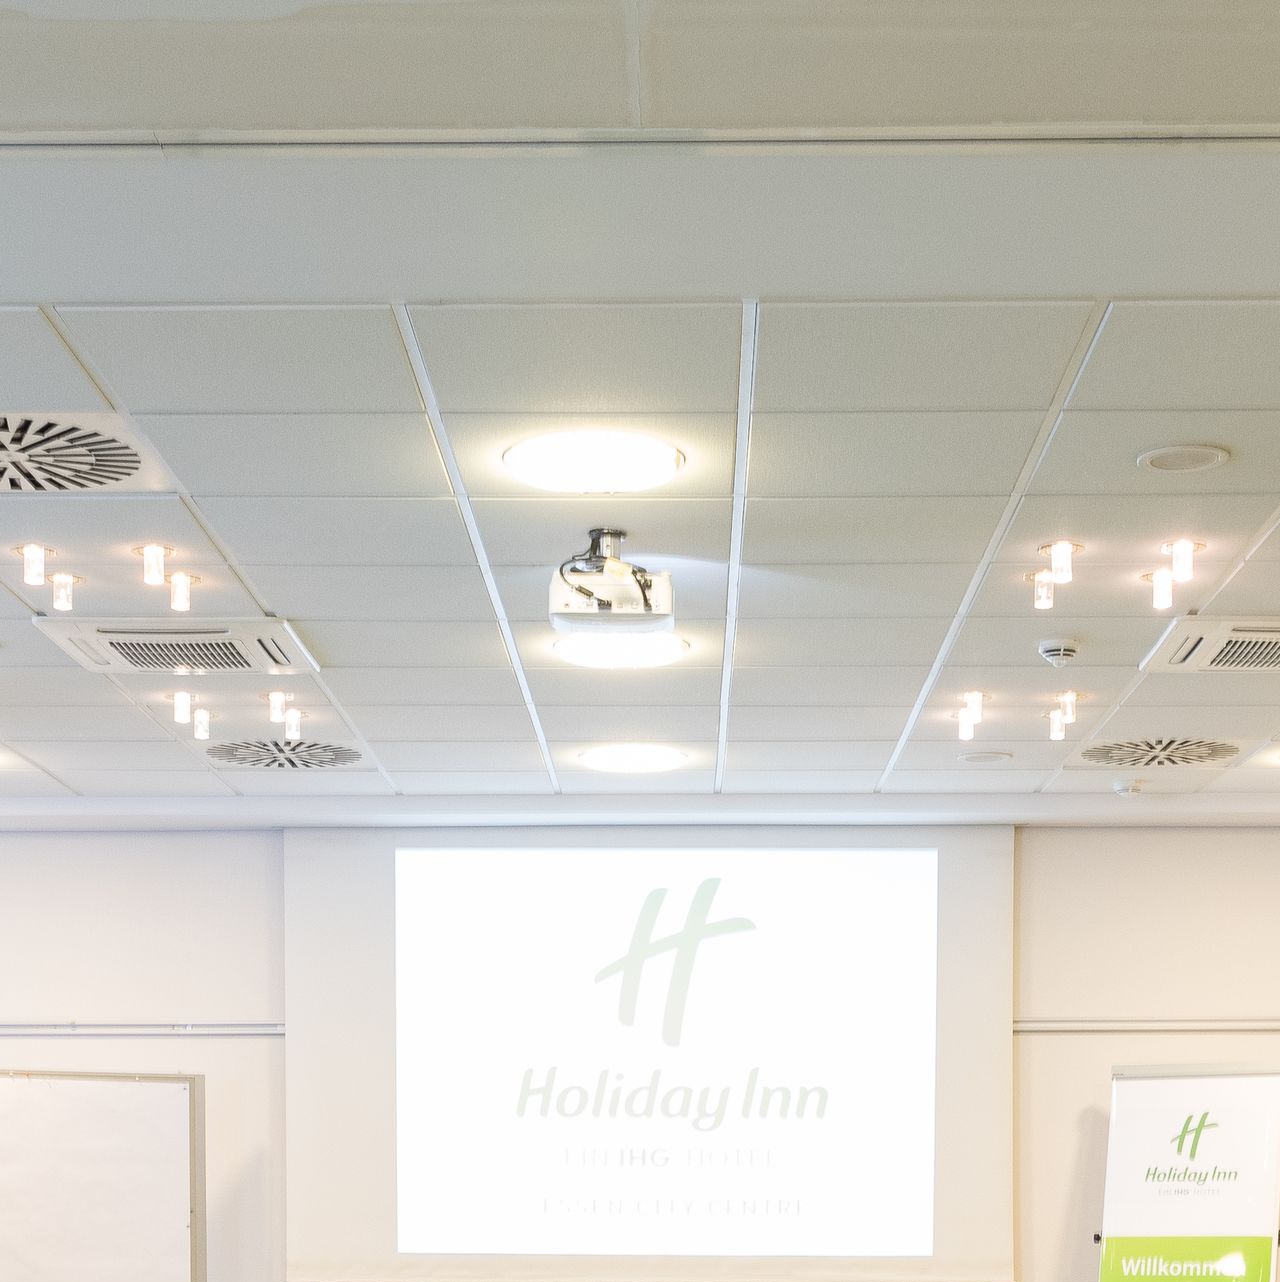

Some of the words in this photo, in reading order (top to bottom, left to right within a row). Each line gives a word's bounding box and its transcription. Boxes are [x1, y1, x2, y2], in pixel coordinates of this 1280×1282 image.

[516, 1066, 730, 1132] Holiday
[741, 1067, 830, 1120] Inn
[618, 1147, 671, 1168] IHG
[1145, 1166, 1208, 1185] Holiday
[1211, 1165, 1238, 1182] Inn
[1121, 1256, 1246, 1277] Willkomm
